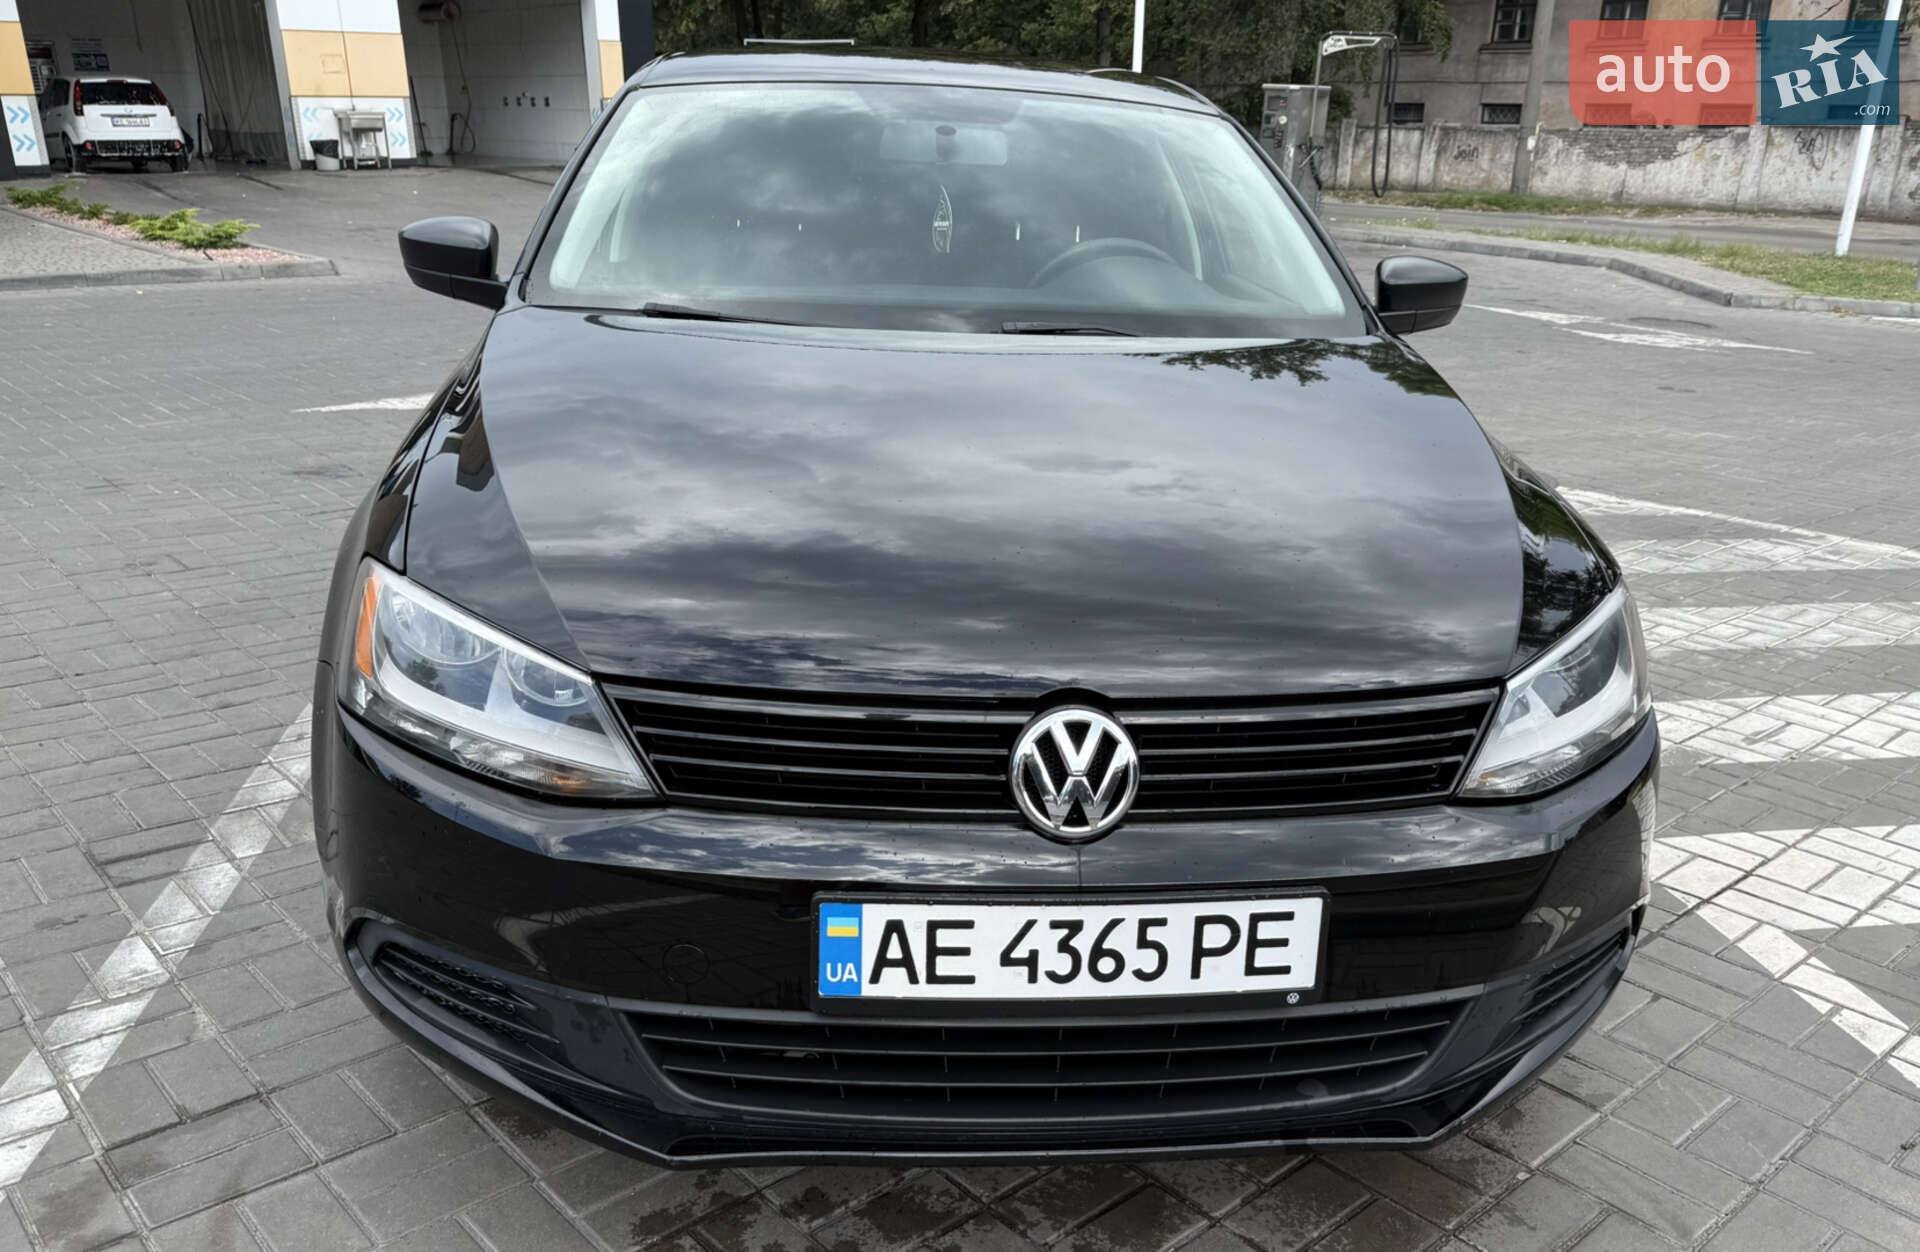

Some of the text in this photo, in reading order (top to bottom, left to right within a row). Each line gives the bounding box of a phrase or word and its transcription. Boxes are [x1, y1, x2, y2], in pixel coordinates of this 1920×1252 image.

[868, 911, 1295, 985] AE 4365 PE
[826, 962, 858, 983] UA
